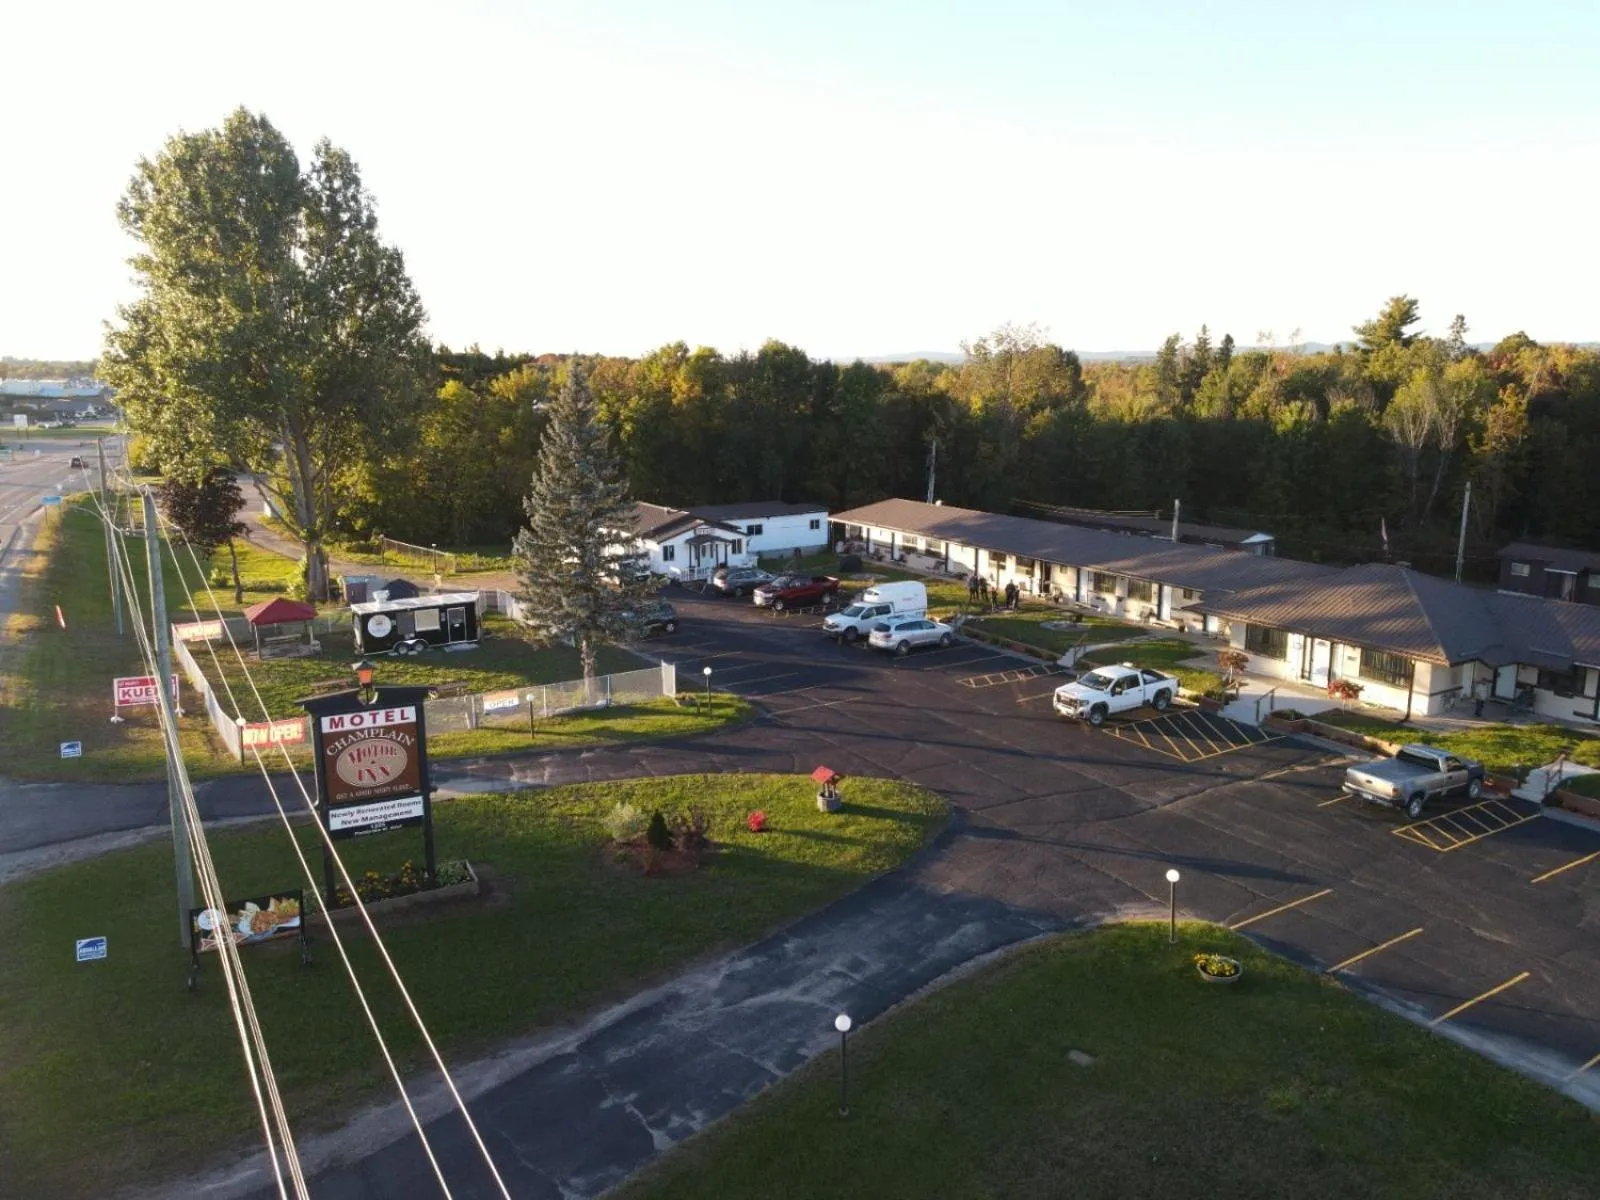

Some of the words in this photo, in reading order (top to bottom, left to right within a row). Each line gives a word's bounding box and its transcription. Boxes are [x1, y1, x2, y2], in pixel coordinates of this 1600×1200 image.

[329, 709, 409, 729] MOTEL
[326, 728, 415, 756] CHAMPLAIN
[348, 744, 398, 764] MOTOR
[357, 766, 391, 781] INN
[331, 810, 354, 819] Newly
[356, 803, 396, 815] Renovated
[341, 818, 360, 826] New
[361, 809, 413, 822] Management
